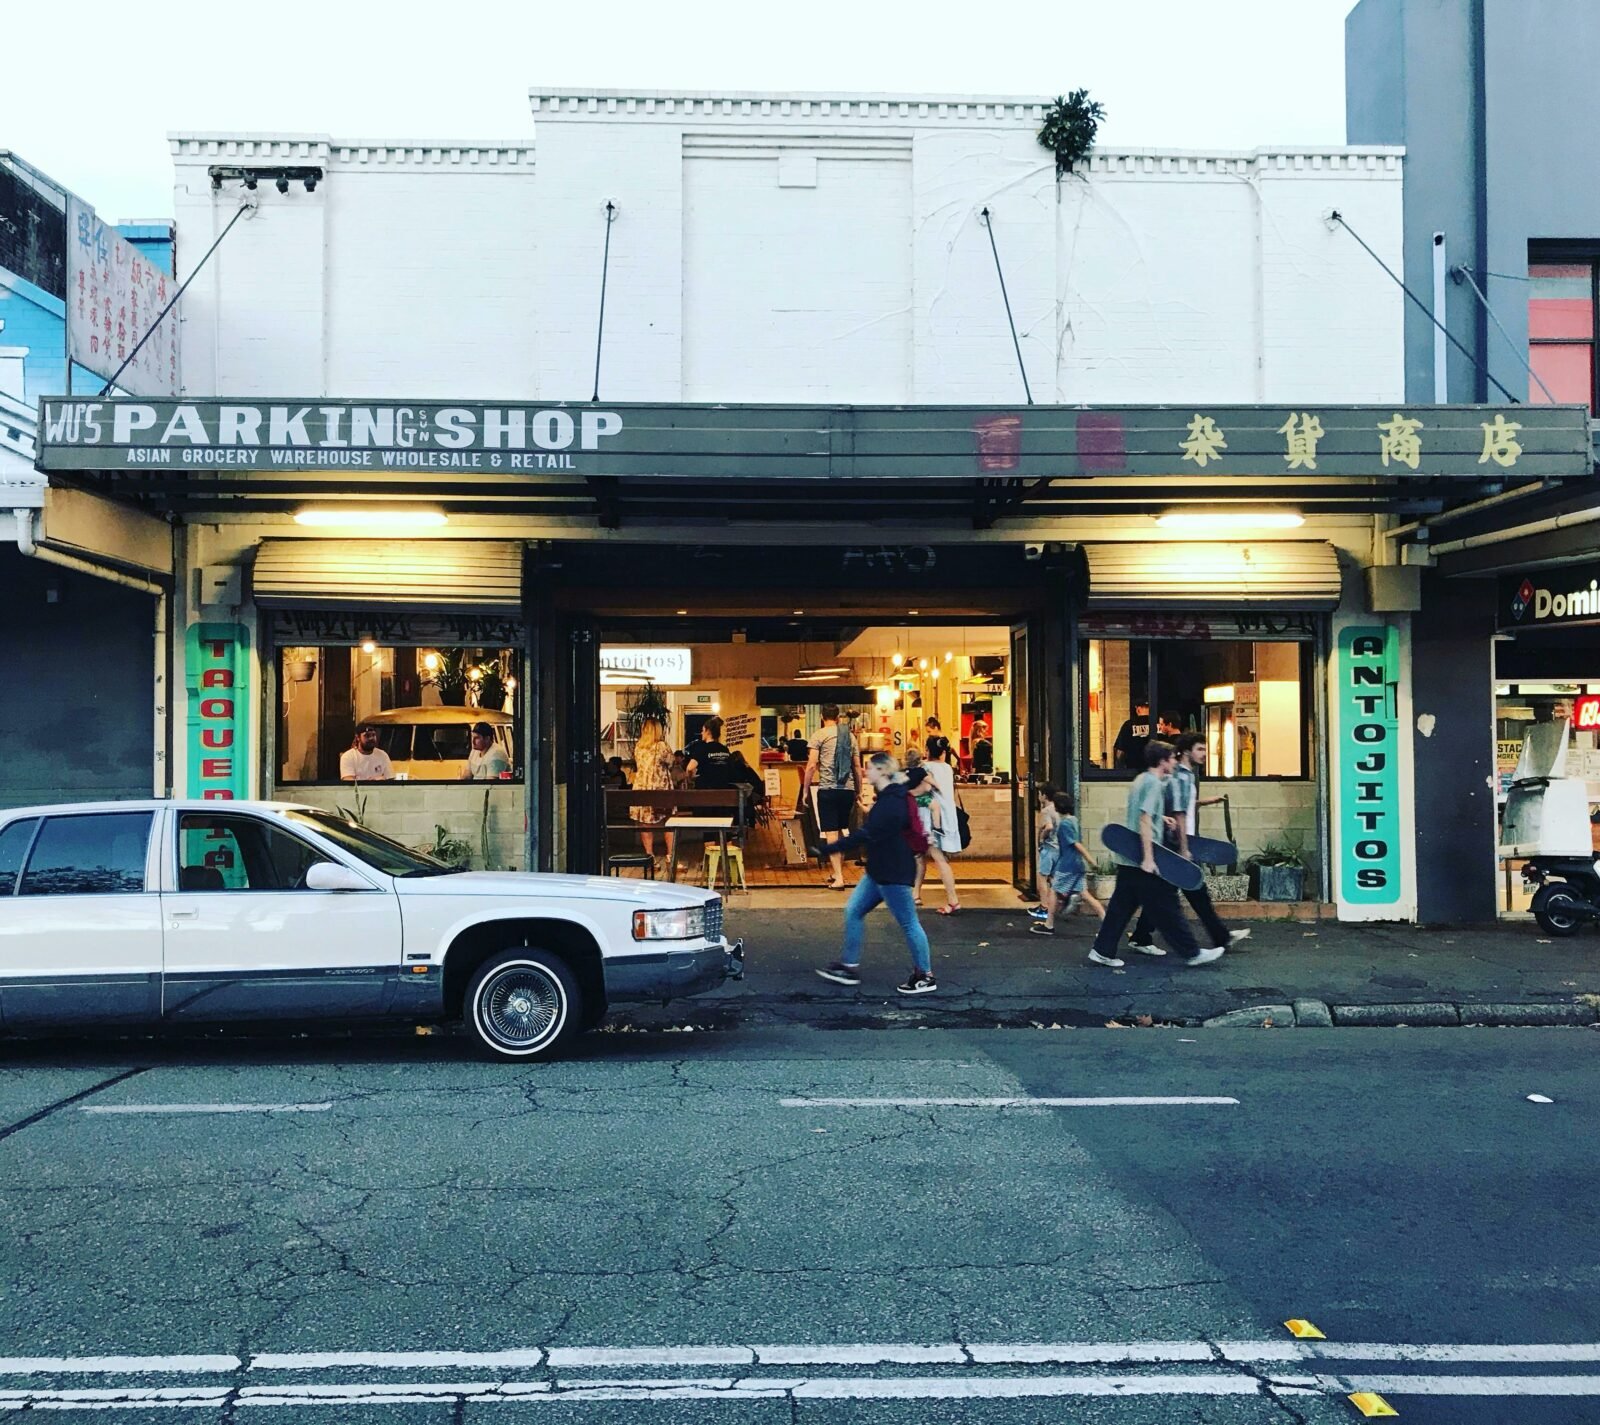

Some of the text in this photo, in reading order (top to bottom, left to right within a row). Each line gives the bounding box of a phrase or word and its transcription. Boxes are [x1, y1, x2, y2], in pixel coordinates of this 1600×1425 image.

[419, 410, 429, 441] SUN
[434, 408, 623, 449] SHOP
[127, 449, 576, 469] ASIAN GROCERY WAREHOUSE WHOLESALE & RETAIL
[1535, 579, 1600, 619] Domi
[894, 731, 901, 745] S
[1352, 636, 1389, 889] ANTOJITOS
